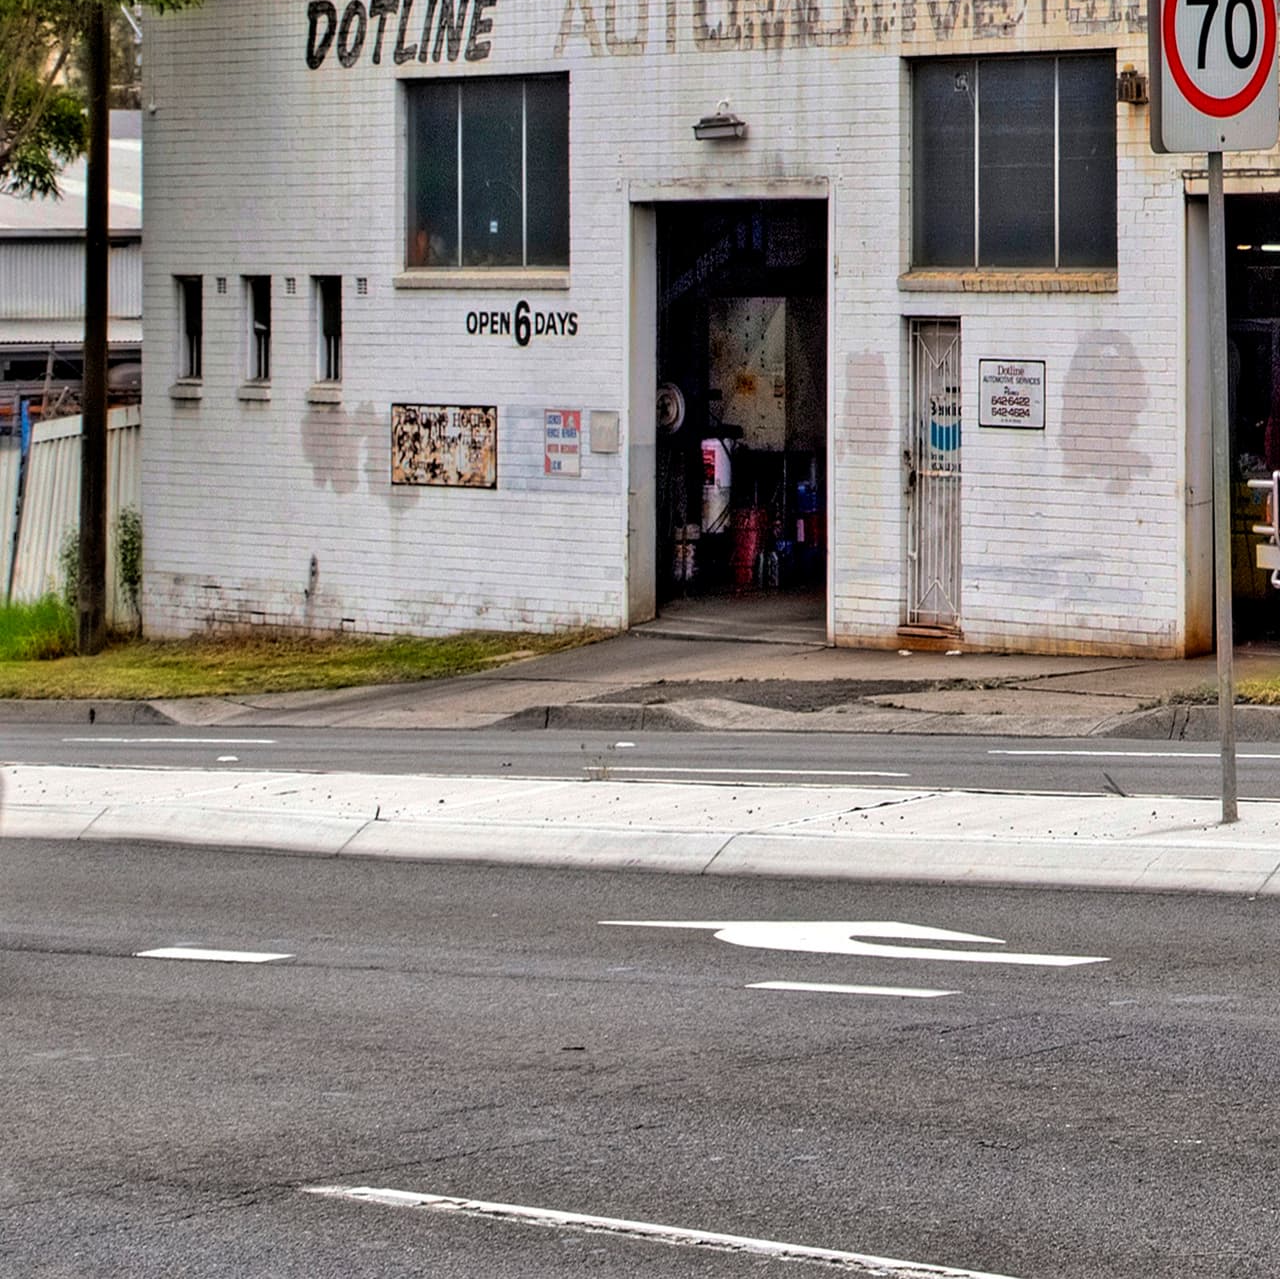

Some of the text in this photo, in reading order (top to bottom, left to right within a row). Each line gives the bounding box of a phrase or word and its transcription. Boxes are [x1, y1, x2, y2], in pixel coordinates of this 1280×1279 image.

[466, 299, 579, 347] OPEN 6 DAYS
[997, 364, 1025, 376] Dotline
